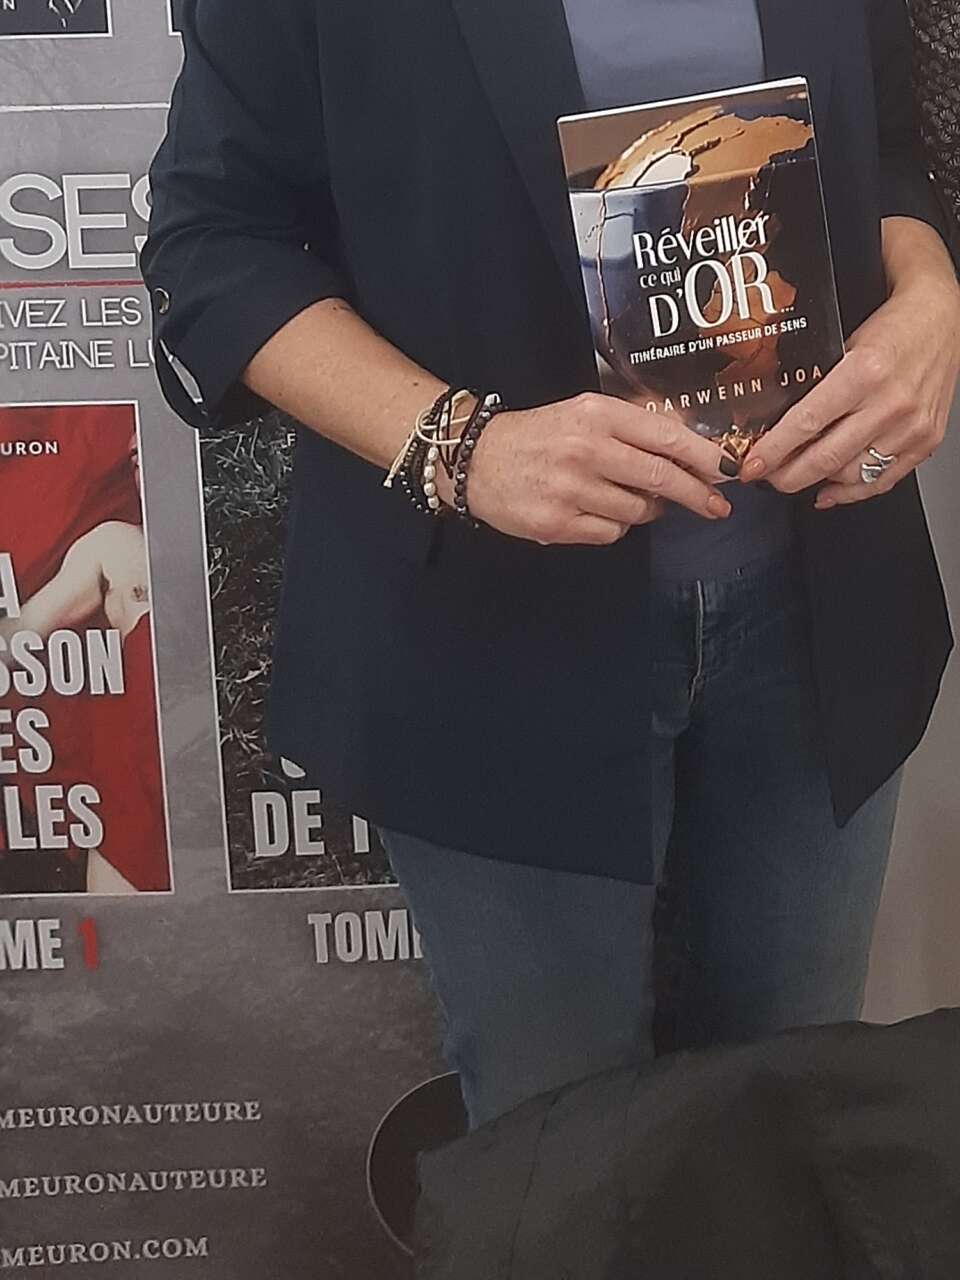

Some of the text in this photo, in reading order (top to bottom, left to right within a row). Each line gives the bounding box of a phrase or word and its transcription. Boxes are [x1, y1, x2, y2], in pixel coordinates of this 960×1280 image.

[632, 211, 771, 269] Réveiller
[81, 297, 142, 326] LES
[630, 341, 687, 365] ITINÉRAIRE
[715, 327, 763, 347] PASSEUR
[764, 321, 778, 337] DE
[780, 316, 808, 335] SENS
[251, 789, 325, 858] DE
